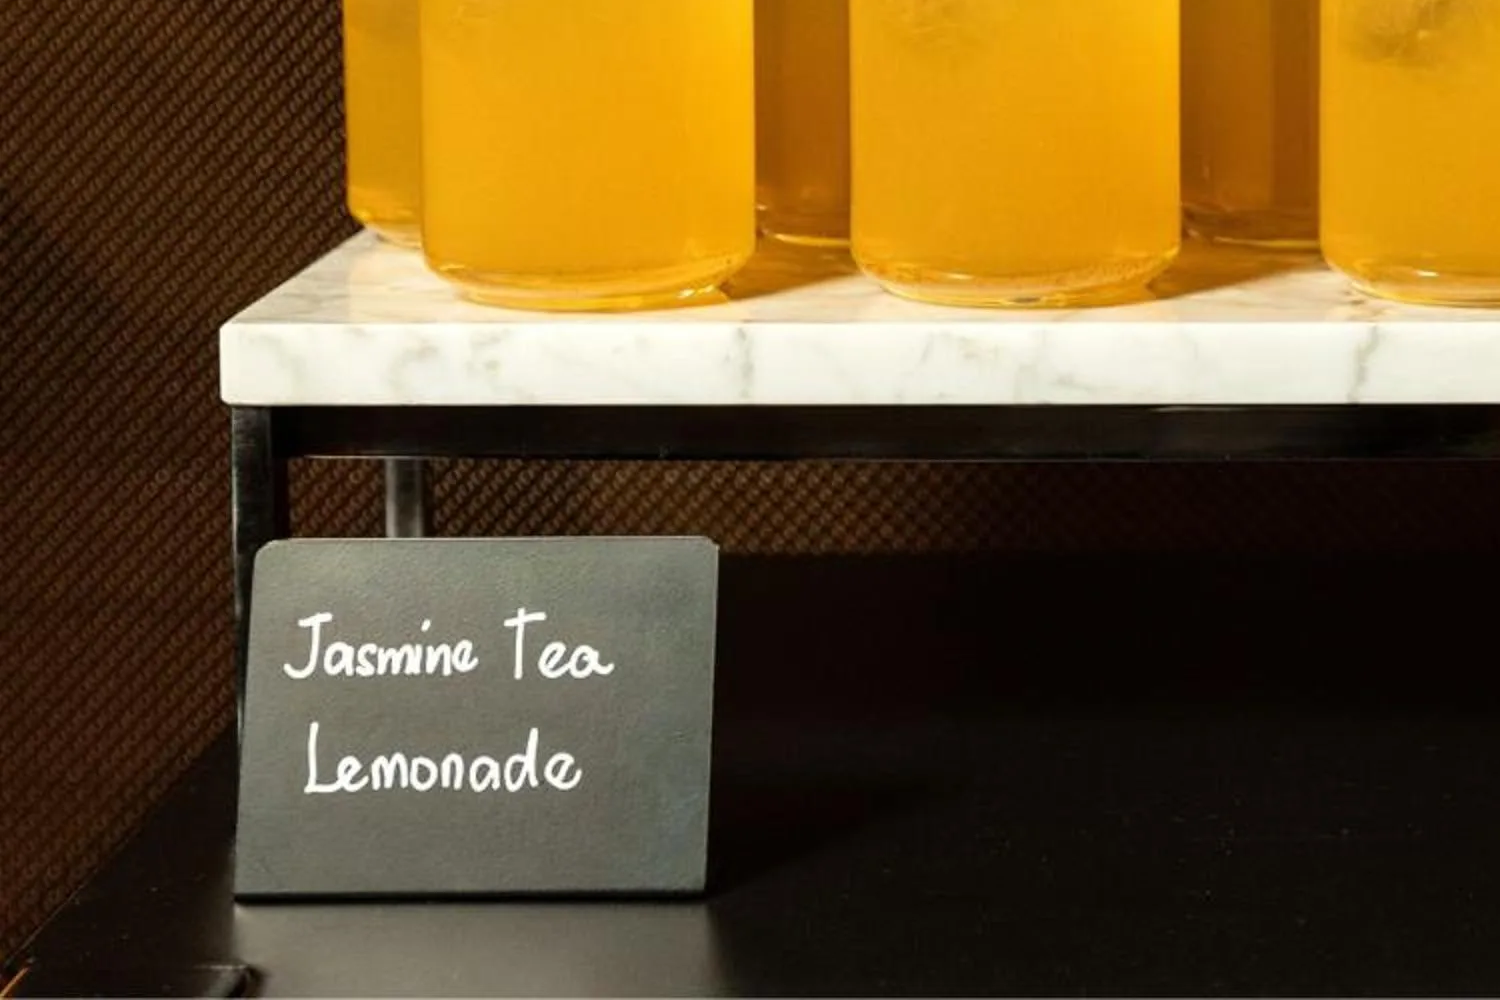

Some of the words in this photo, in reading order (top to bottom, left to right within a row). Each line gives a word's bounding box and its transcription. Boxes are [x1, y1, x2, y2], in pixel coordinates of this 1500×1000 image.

[282, 611, 480, 680] Jasmine
[503, 606, 615, 681] Tea
[303, 720, 583, 795] Lemonade
